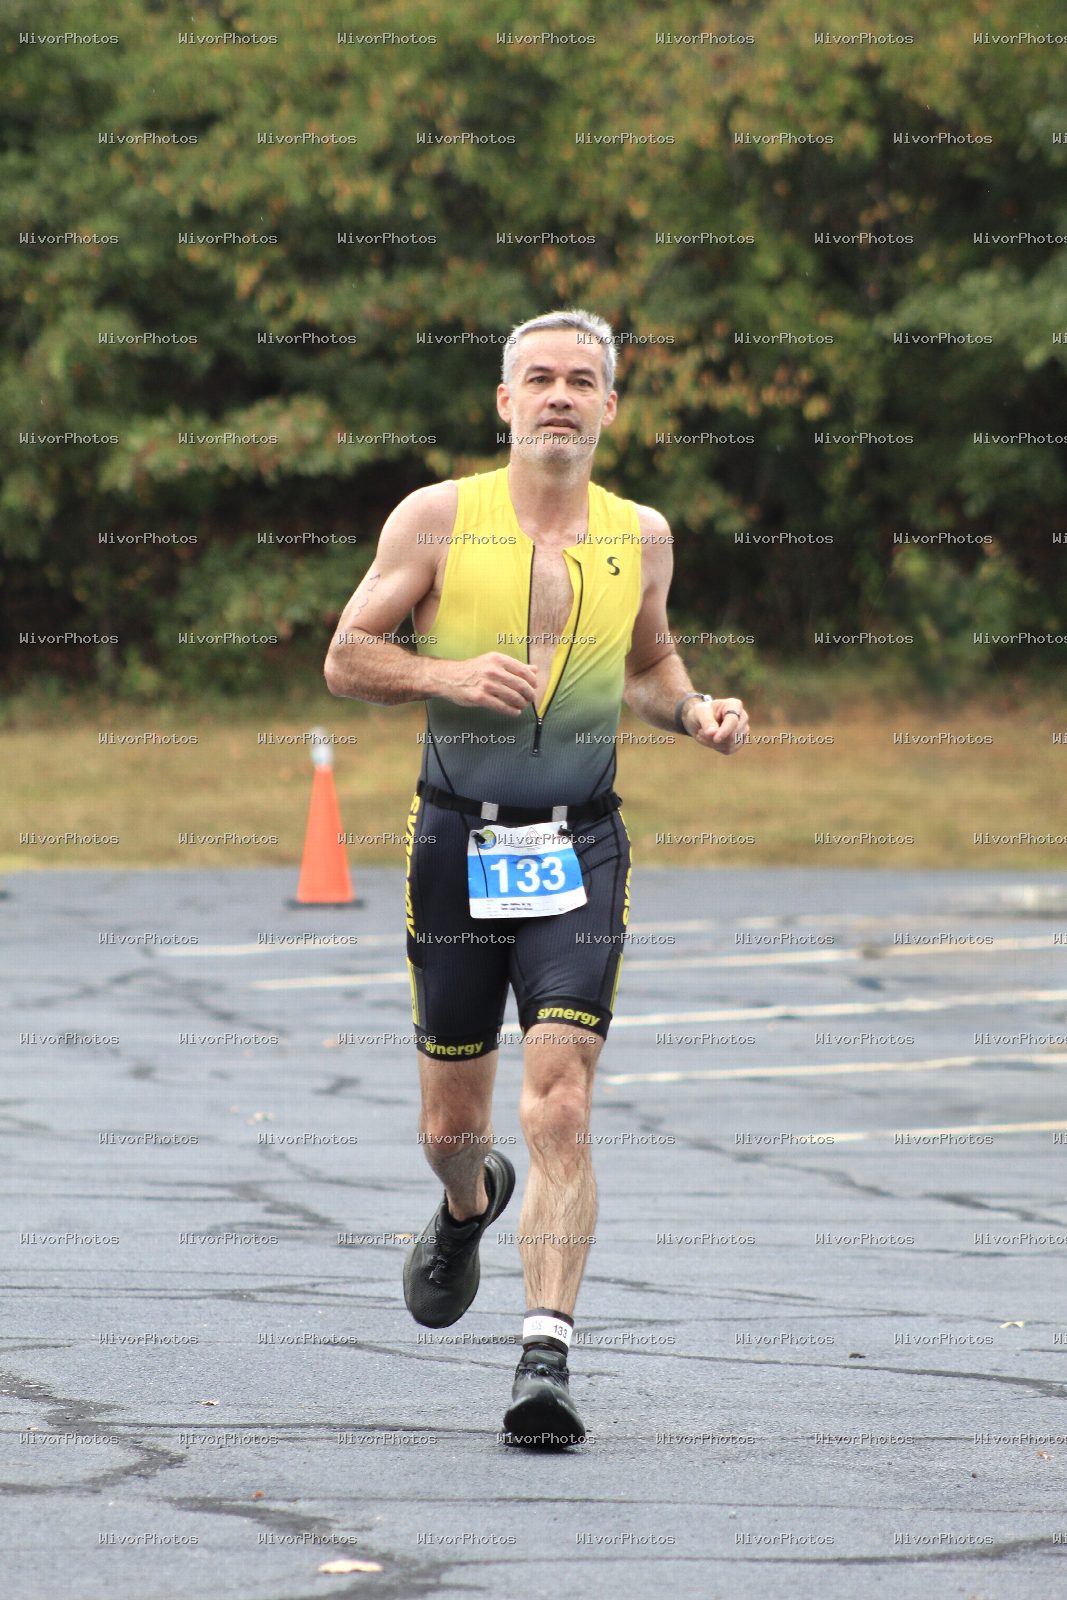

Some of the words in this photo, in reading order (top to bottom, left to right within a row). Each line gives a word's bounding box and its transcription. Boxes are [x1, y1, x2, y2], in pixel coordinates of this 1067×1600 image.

[490, 856, 566, 893] 133
[537, 1006, 600, 1027] synergy
[425, 1041, 484, 1056] synergy
[554, 1325, 568, 1338] 133
